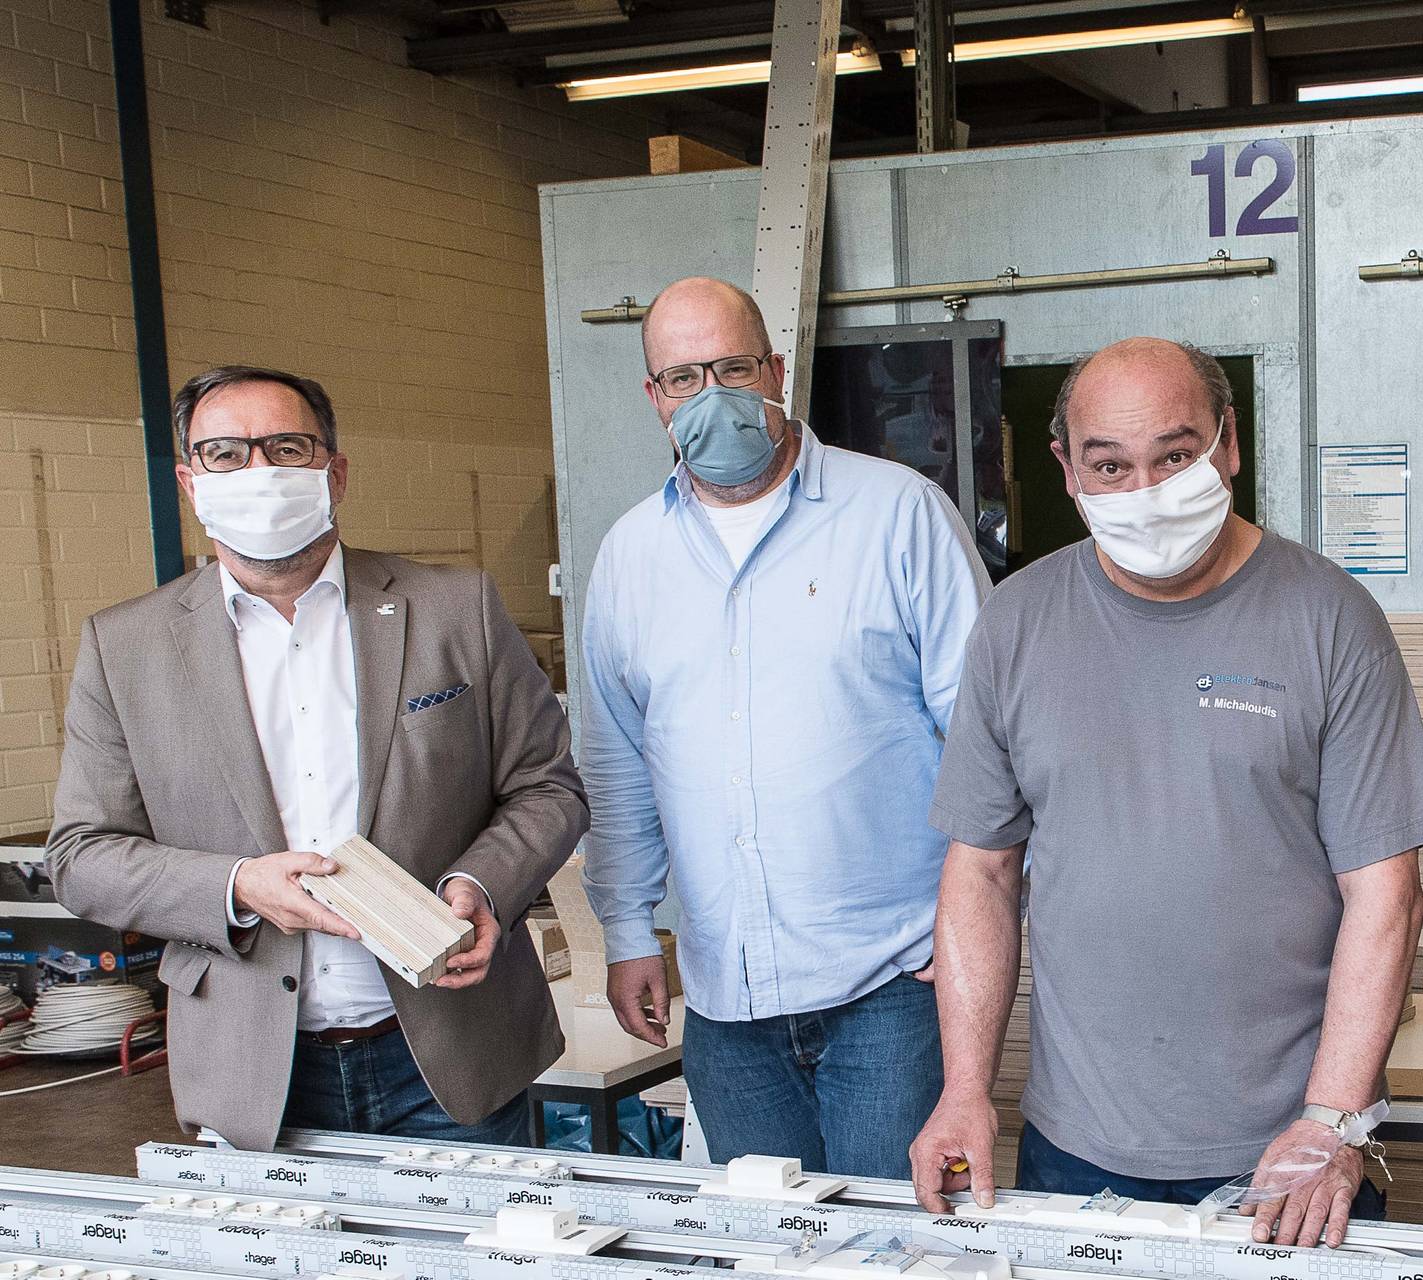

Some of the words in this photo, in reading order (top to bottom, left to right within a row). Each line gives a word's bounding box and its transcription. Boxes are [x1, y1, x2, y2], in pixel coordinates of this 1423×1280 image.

[1190, 139, 1299, 237] 12
[1198, 697, 1211, 708] M.
[1214, 697, 1278, 718] Michaloudis
[178, 1171, 206, 1183] :hager
[265, 1168, 307, 1187] :hager
[419, 1193, 449, 1207] :hager
[82, 1224, 127, 1244] :hager
[674, 1218, 707, 1231] :hager
[778, 1216, 828, 1237] :hager
[245, 1252, 277, 1266] :hager
[339, 1250, 388, 1271] :hager
[1067, 1244, 1122, 1265] :hager
